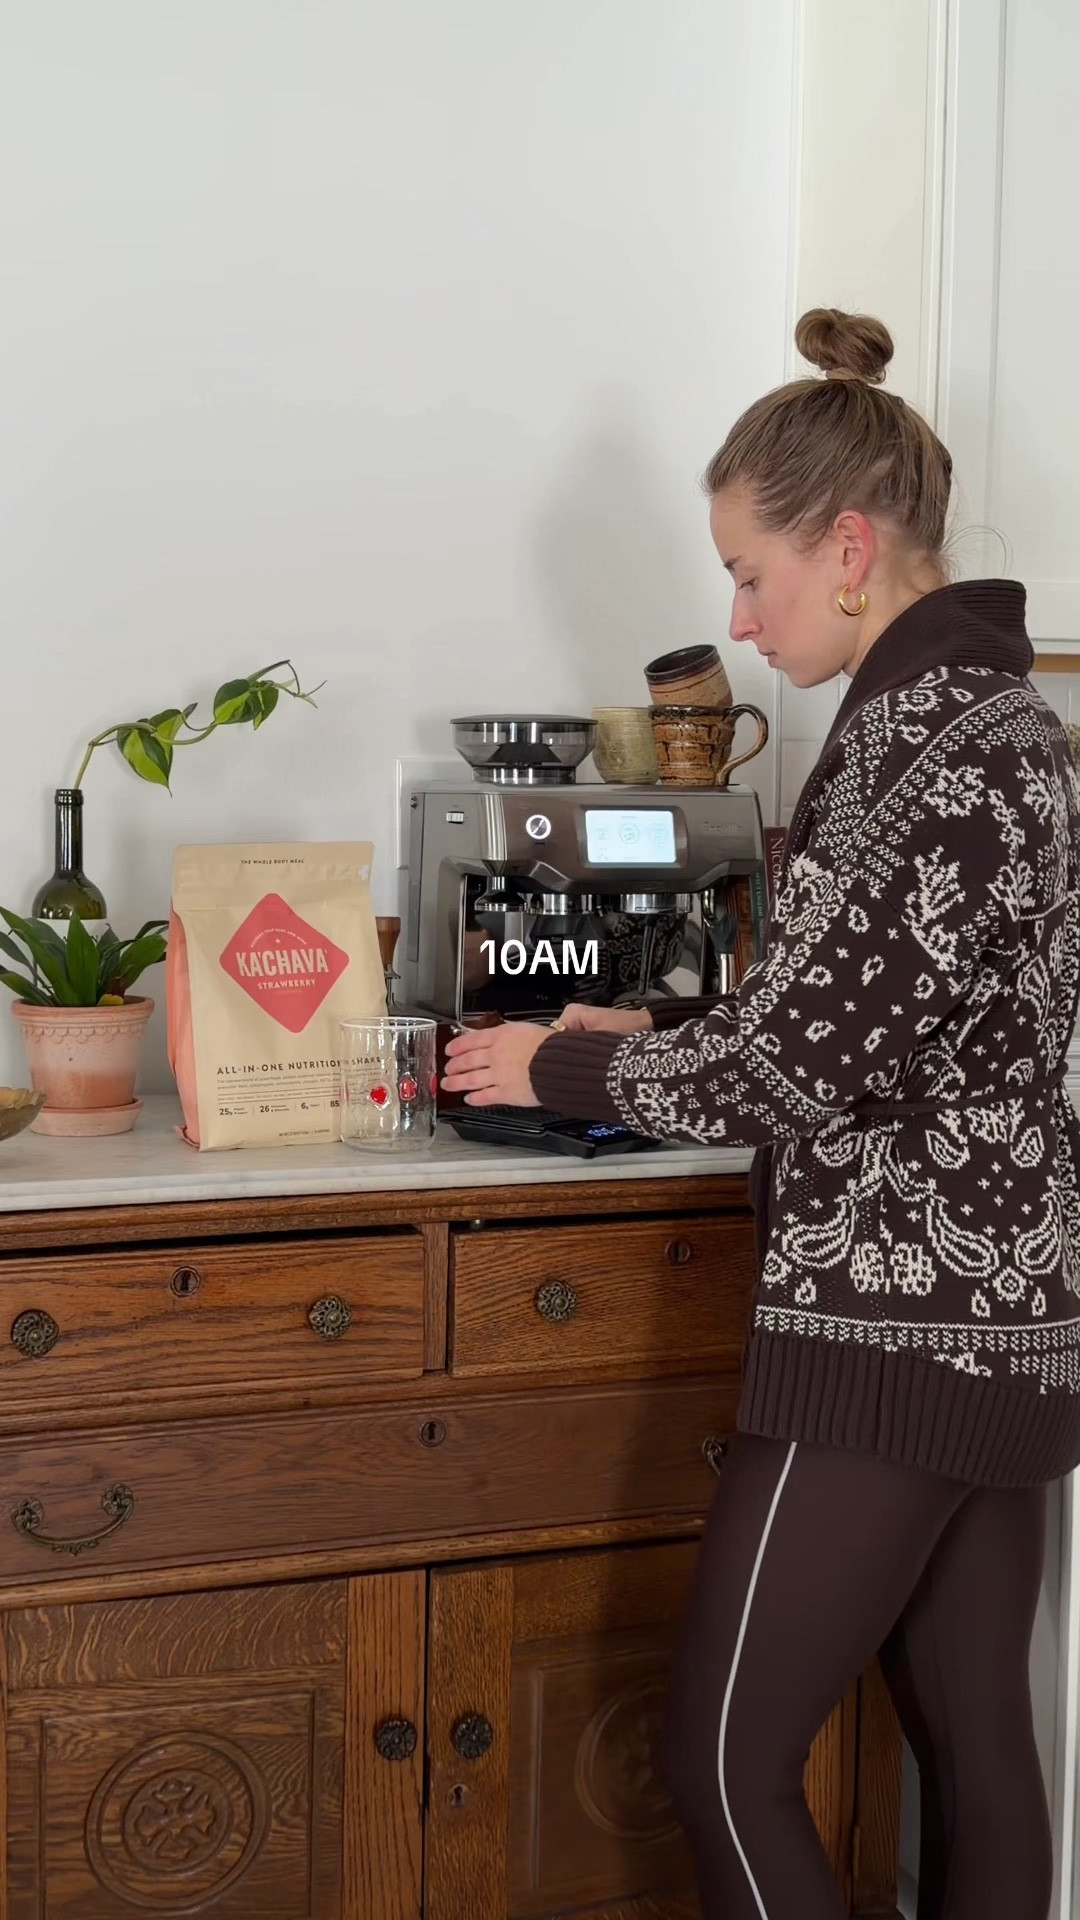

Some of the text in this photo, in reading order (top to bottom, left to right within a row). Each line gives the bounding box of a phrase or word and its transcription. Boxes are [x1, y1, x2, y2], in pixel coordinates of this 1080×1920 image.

[258, 978, 316, 990] STRAWBERRY
[216, 1063, 284, 1075] ALL-IN-ONE
[351, 1055, 382, 1066] SHAKE
